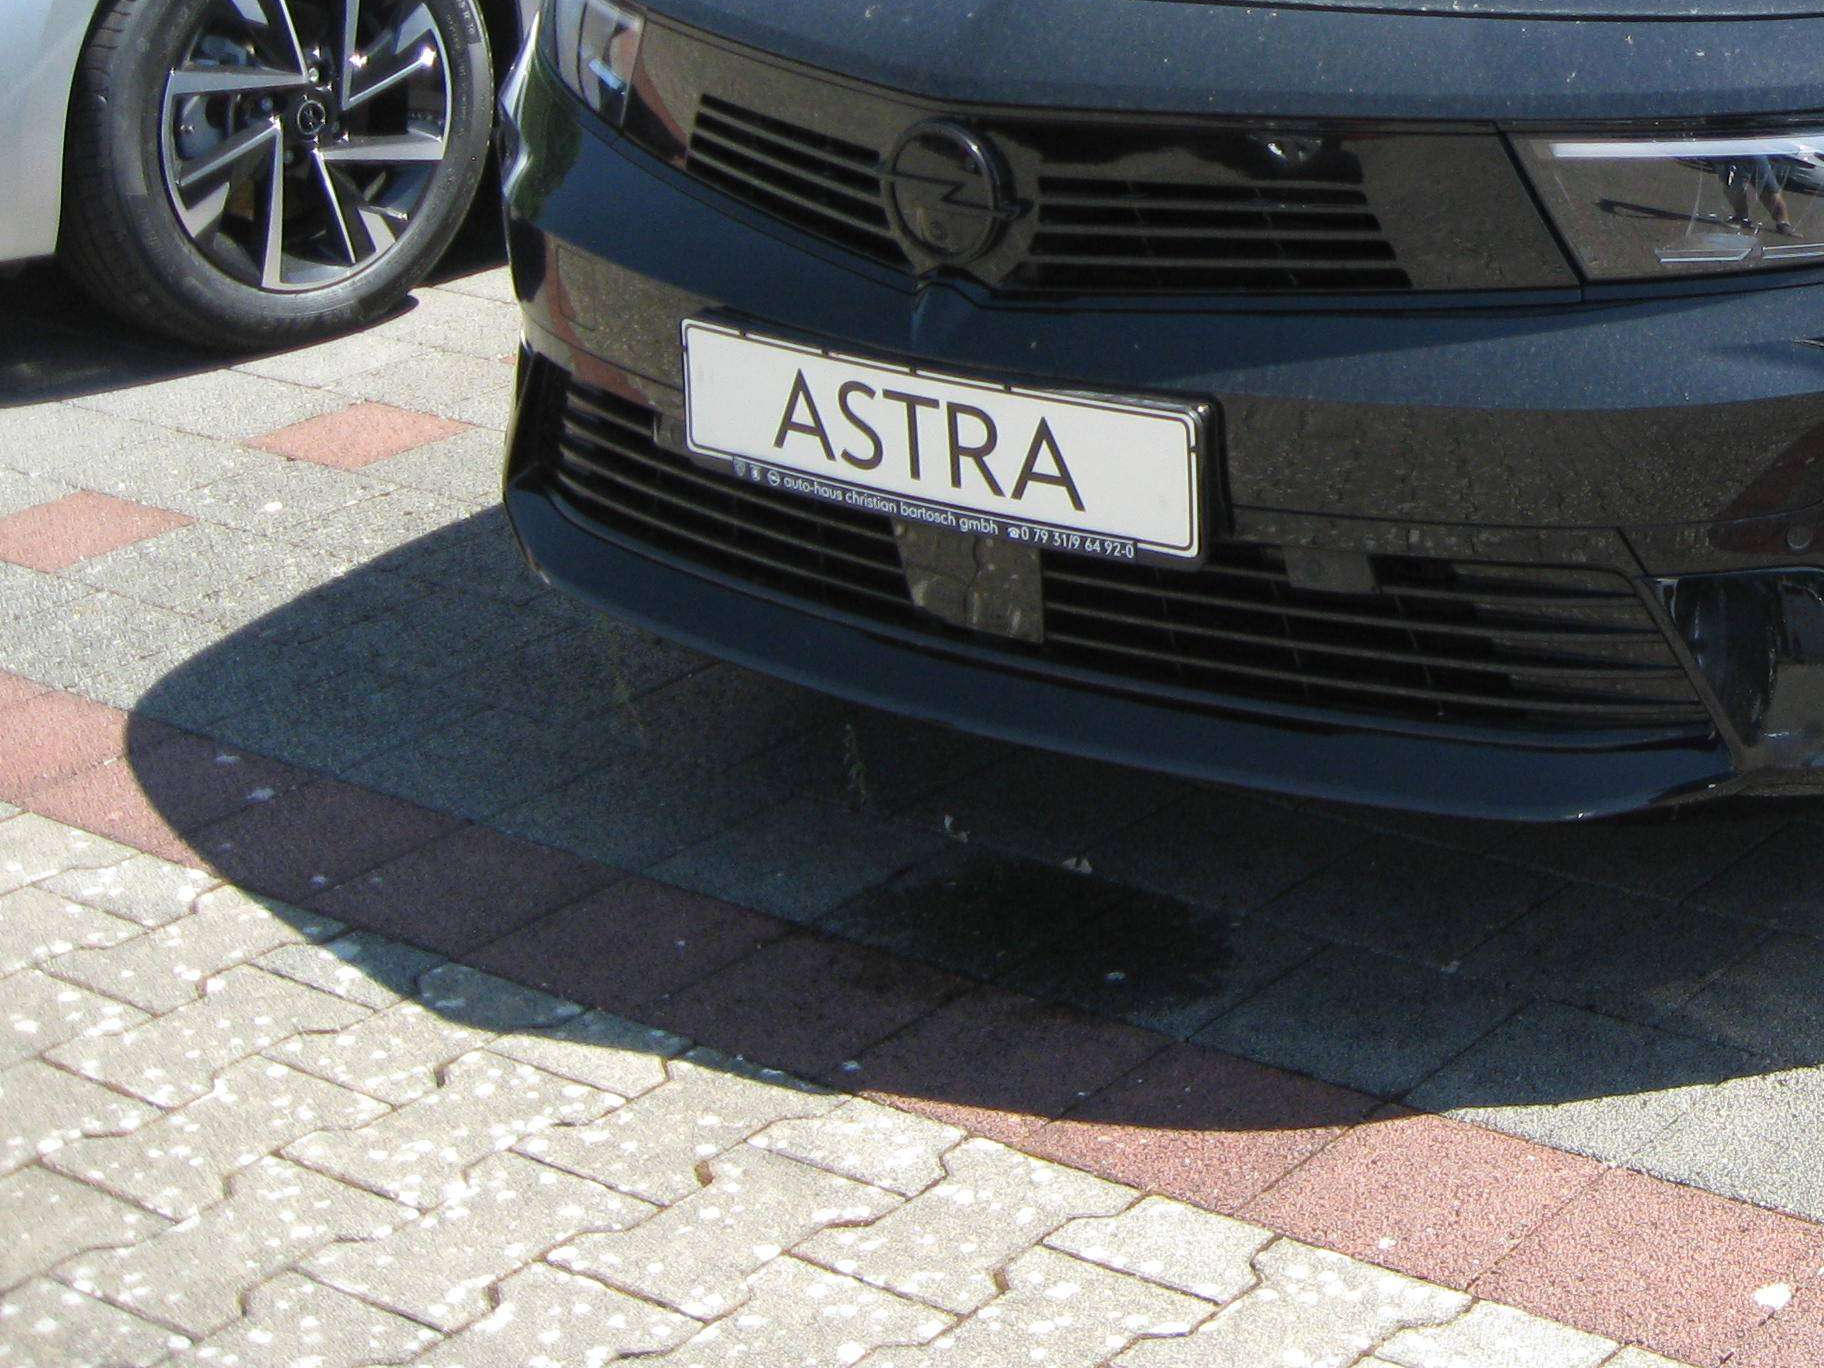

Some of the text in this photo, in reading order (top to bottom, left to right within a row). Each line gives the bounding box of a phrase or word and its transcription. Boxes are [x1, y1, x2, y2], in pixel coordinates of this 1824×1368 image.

[772, 368, 1086, 512] ASTRA
[784, 477, 843, 501] auto-haus
[845, 491, 897, 513] christian
[900, 502, 956, 526] bartosch
[959, 517, 999, 535] gmbh
[1033, 529, 1049, 544] 79
[1084, 538, 1101, 553] 64
[1104, 540, 1135, 559] 92-0
